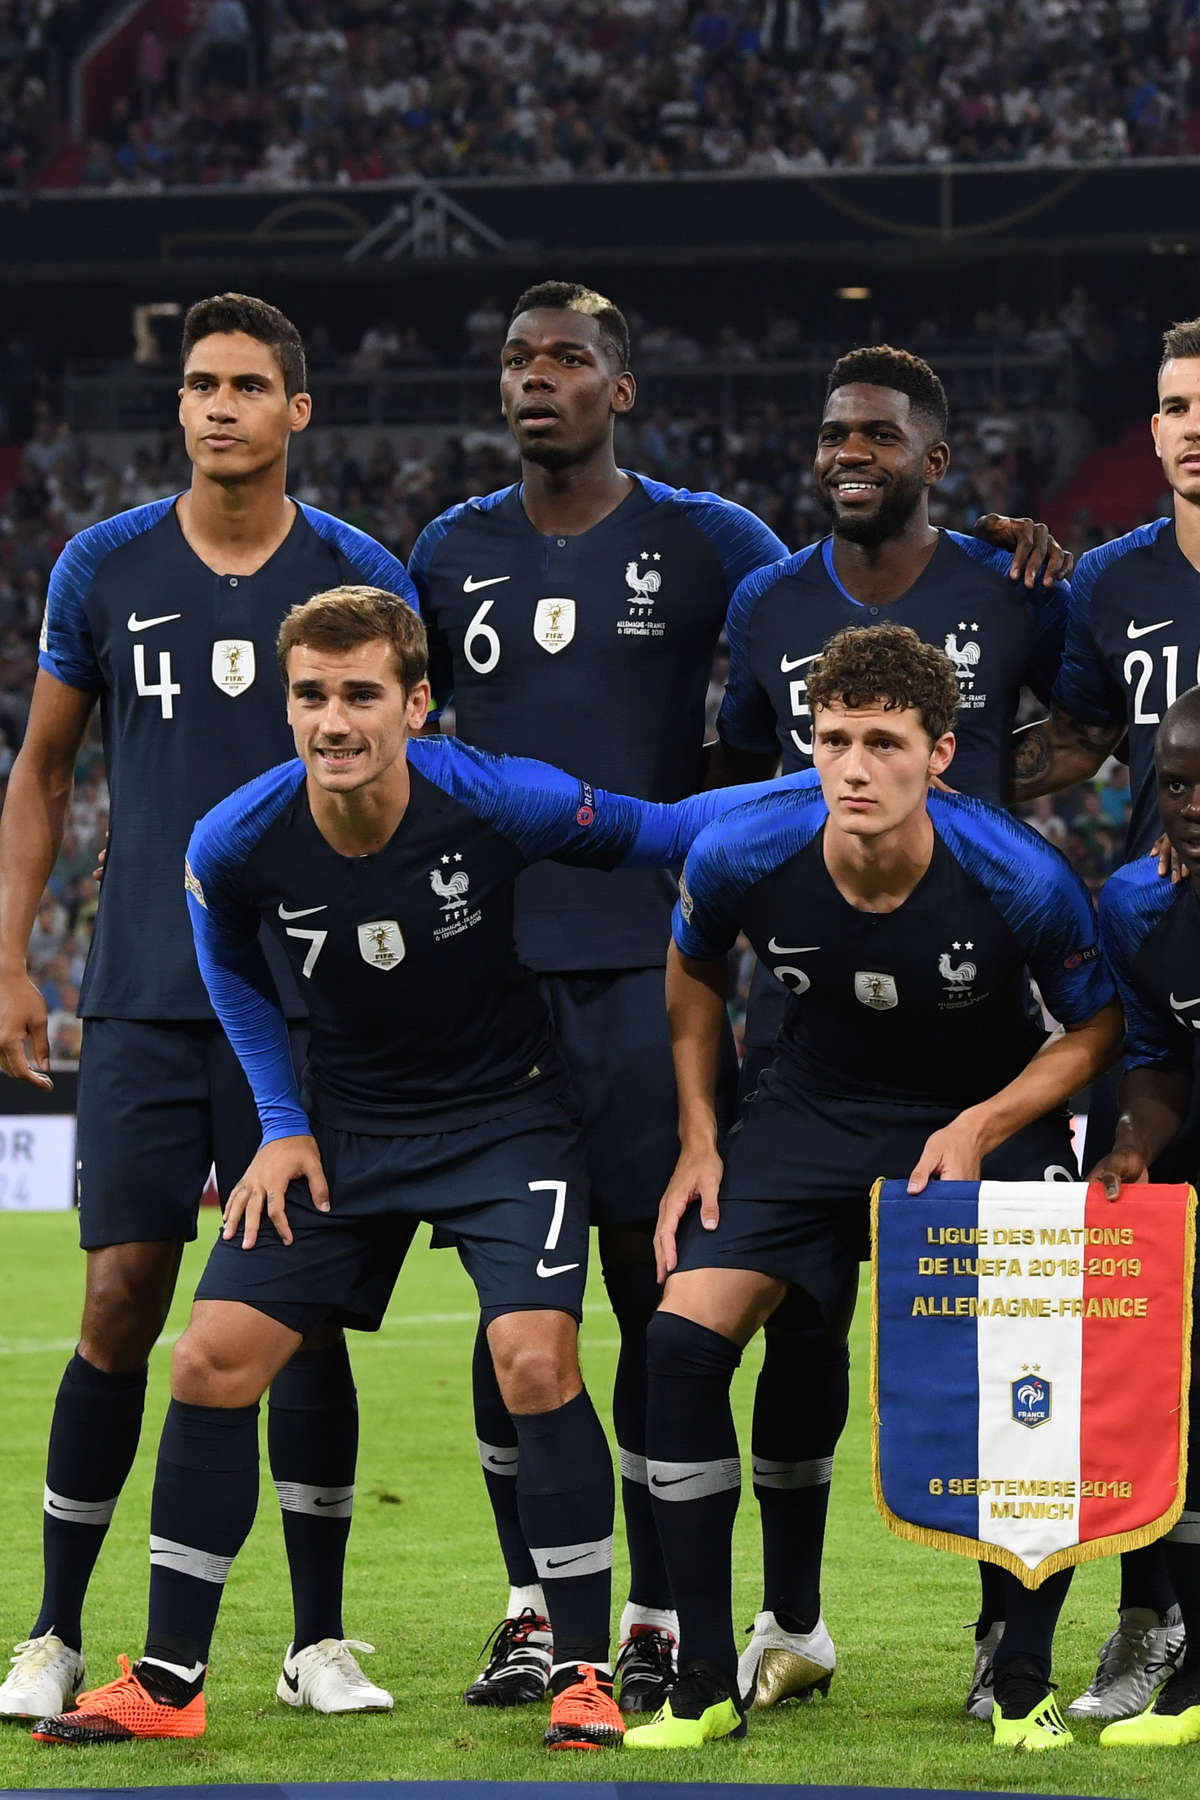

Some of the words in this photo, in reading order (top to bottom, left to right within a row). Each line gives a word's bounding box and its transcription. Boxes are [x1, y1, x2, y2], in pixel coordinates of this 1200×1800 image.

[464, 600, 500, 674] 6
[133, 644, 181, 719] 4
[1124, 646, 1178, 724] 21
[286, 927, 328, 979] 7
[528, 1180, 567, 1250] 7
[927, 1227, 988, 1246] LIGUE
[993, 1228, 1035, 1246] DES
[1040, 1228, 1134, 1246] NATIONS
[918, 1257, 948, 1276] DE
[953, 1257, 1023, 1277] L'UEFA
[1028, 1258, 1142, 1277] 2018-2019
[911, 1296, 1148, 1318] ALLEMAGNE-FRANCE
[929, 1478, 943, 1496] 6
[948, 1478, 1076, 1498] SEPTEMBRE
[1080, 1480, 1133, 1498] 2018
[990, 1501, 1074, 1520] MUNICH
